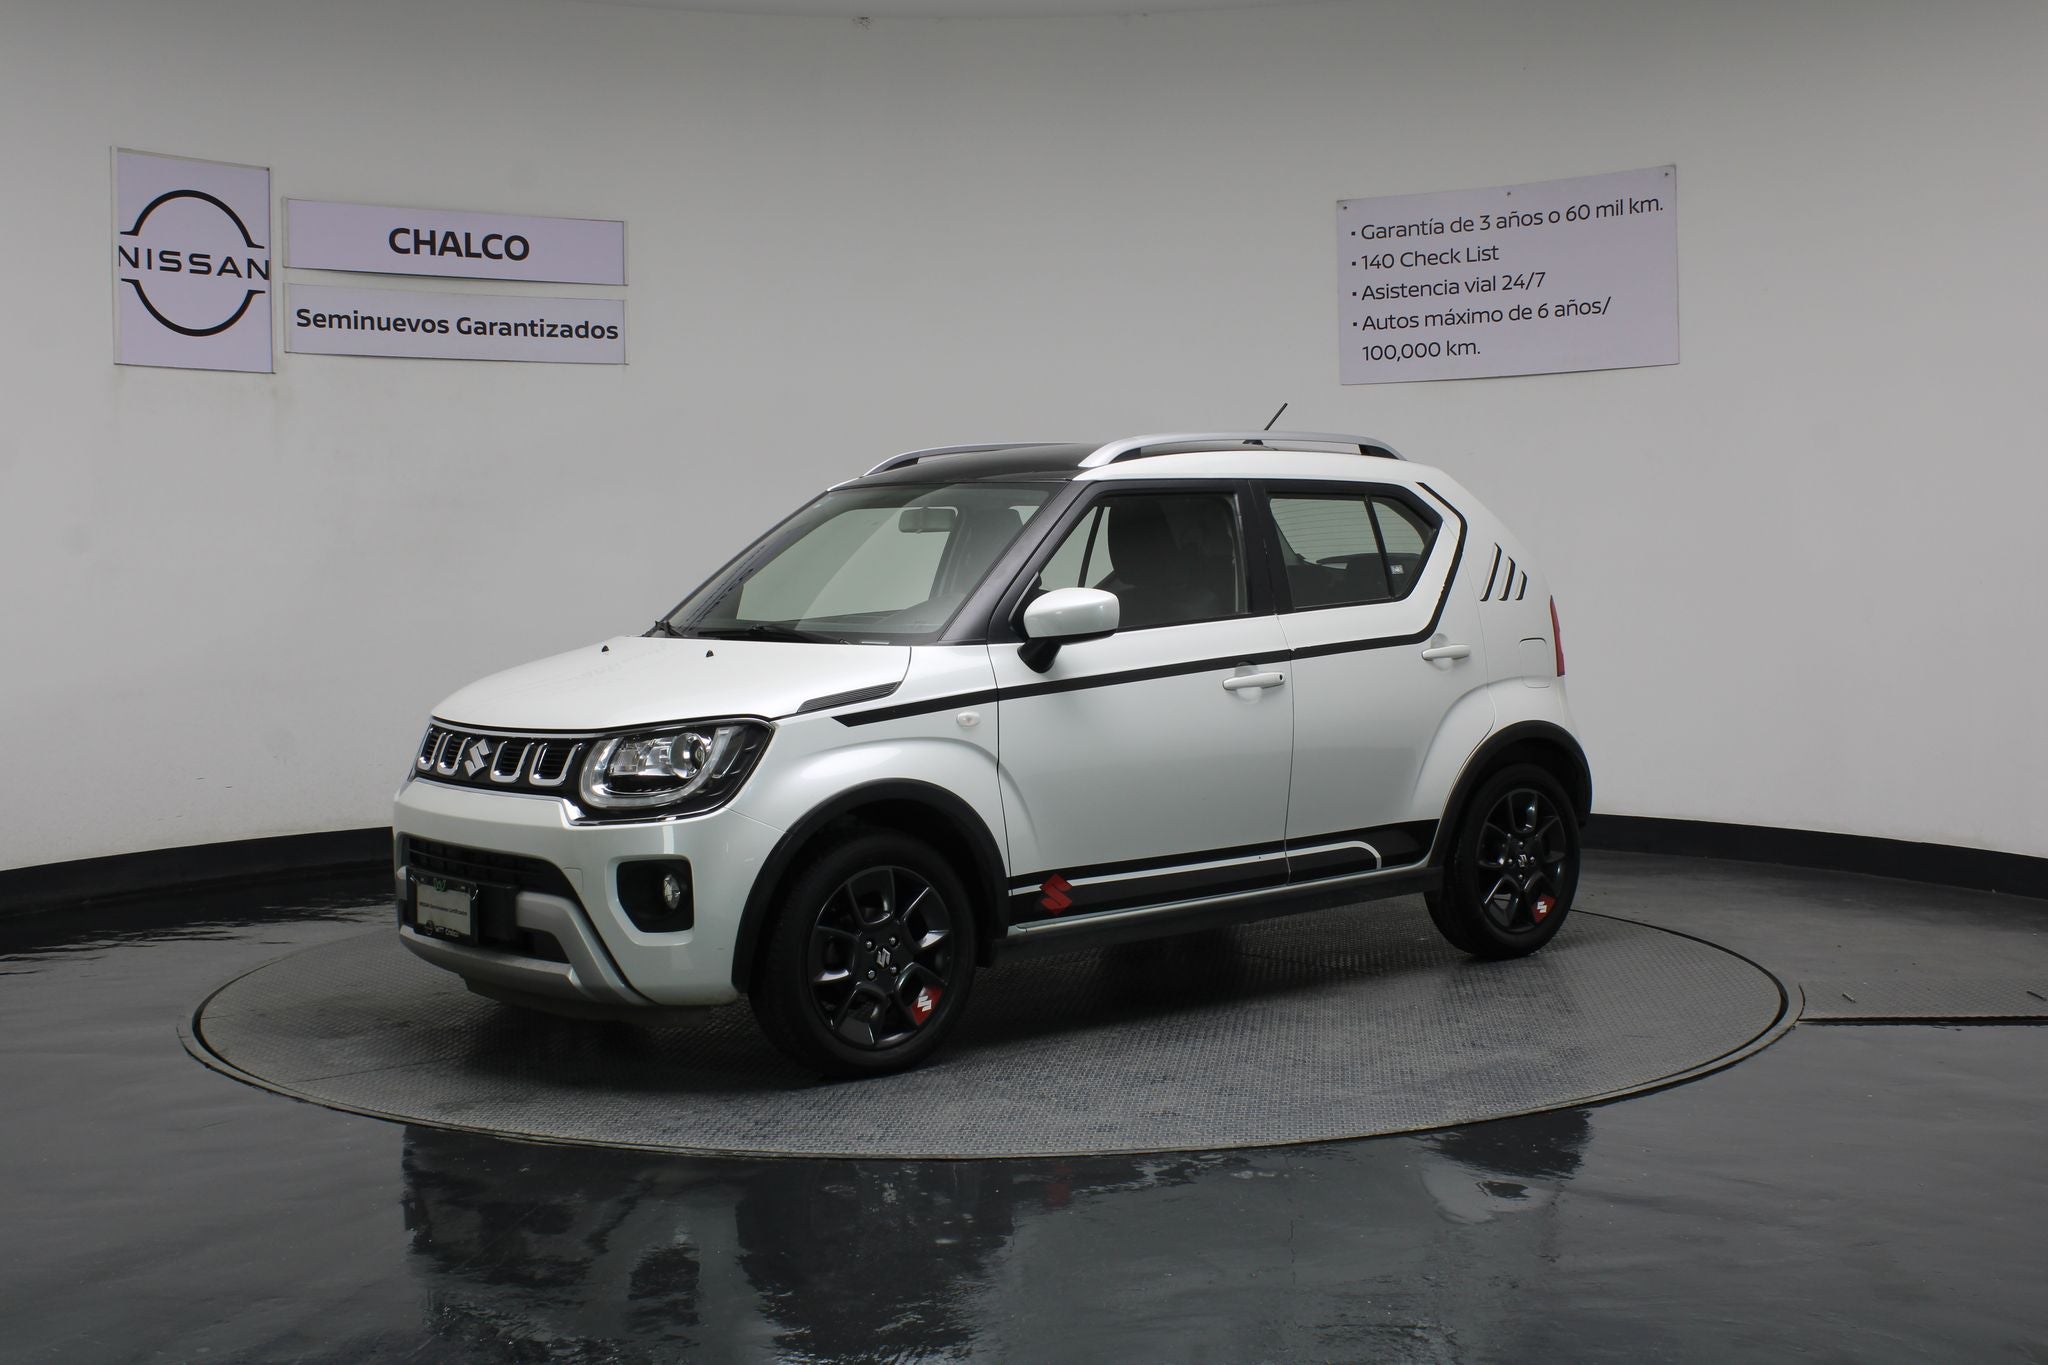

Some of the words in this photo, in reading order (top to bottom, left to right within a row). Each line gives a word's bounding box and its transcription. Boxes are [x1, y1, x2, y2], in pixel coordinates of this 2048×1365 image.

[1360, 217, 1445, 240] Garantía
[1449, 216, 1475, 234] de
[1479, 214, 1491, 231] 3
[1495, 210, 1544, 230] años
[1548, 210, 1561, 224] o
[1565, 203, 1591, 222] 60
[1595, 198, 1624, 219] mil
[1628, 197, 1664, 215] km.
[388, 227, 530, 262] CHALCO
[1360, 253, 1395, 271] 140
[1399, 247, 1462, 268] Check
[1466, 245, 1500, 263] List
[118, 244, 272, 281] NISSAN
[1361, 279, 1460, 301] Asistencia
[1463, 274, 1496, 294] vial
[1501, 271, 1546, 291] 24/7
[296, 308, 450, 335] Seminuevos
[456, 316, 619, 340] Garantizados
[1361, 313, 1420, 332] Autos
[1424, 307, 1504, 328] máximo
[1508, 303, 1533, 322] de
[1537, 302, 1549, 319] 6
[1554, 295, 1612, 318] años/
[1362, 341, 1441, 362] 100,000
[1446, 340, 1481, 357] km.
